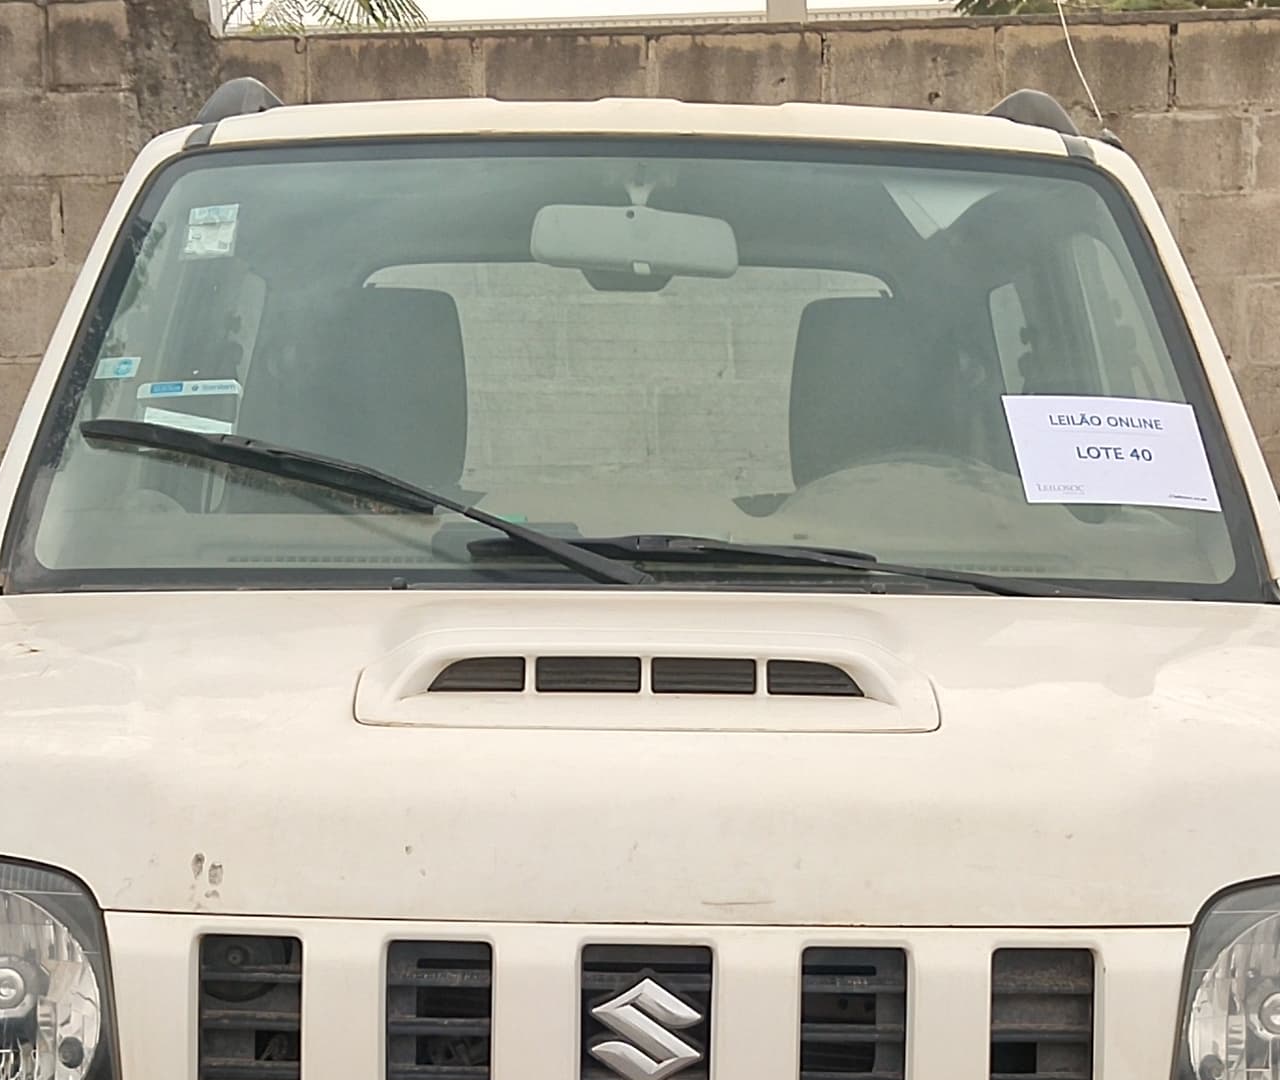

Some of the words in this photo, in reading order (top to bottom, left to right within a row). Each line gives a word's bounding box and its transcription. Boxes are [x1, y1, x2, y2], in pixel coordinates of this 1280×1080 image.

[1048, 413, 1102, 427] LEILÃO
[1106, 416, 1164, 430] ONLINE
[1075, 446, 1125, 460] LOTE
[1129, 448, 1153, 462] 40
